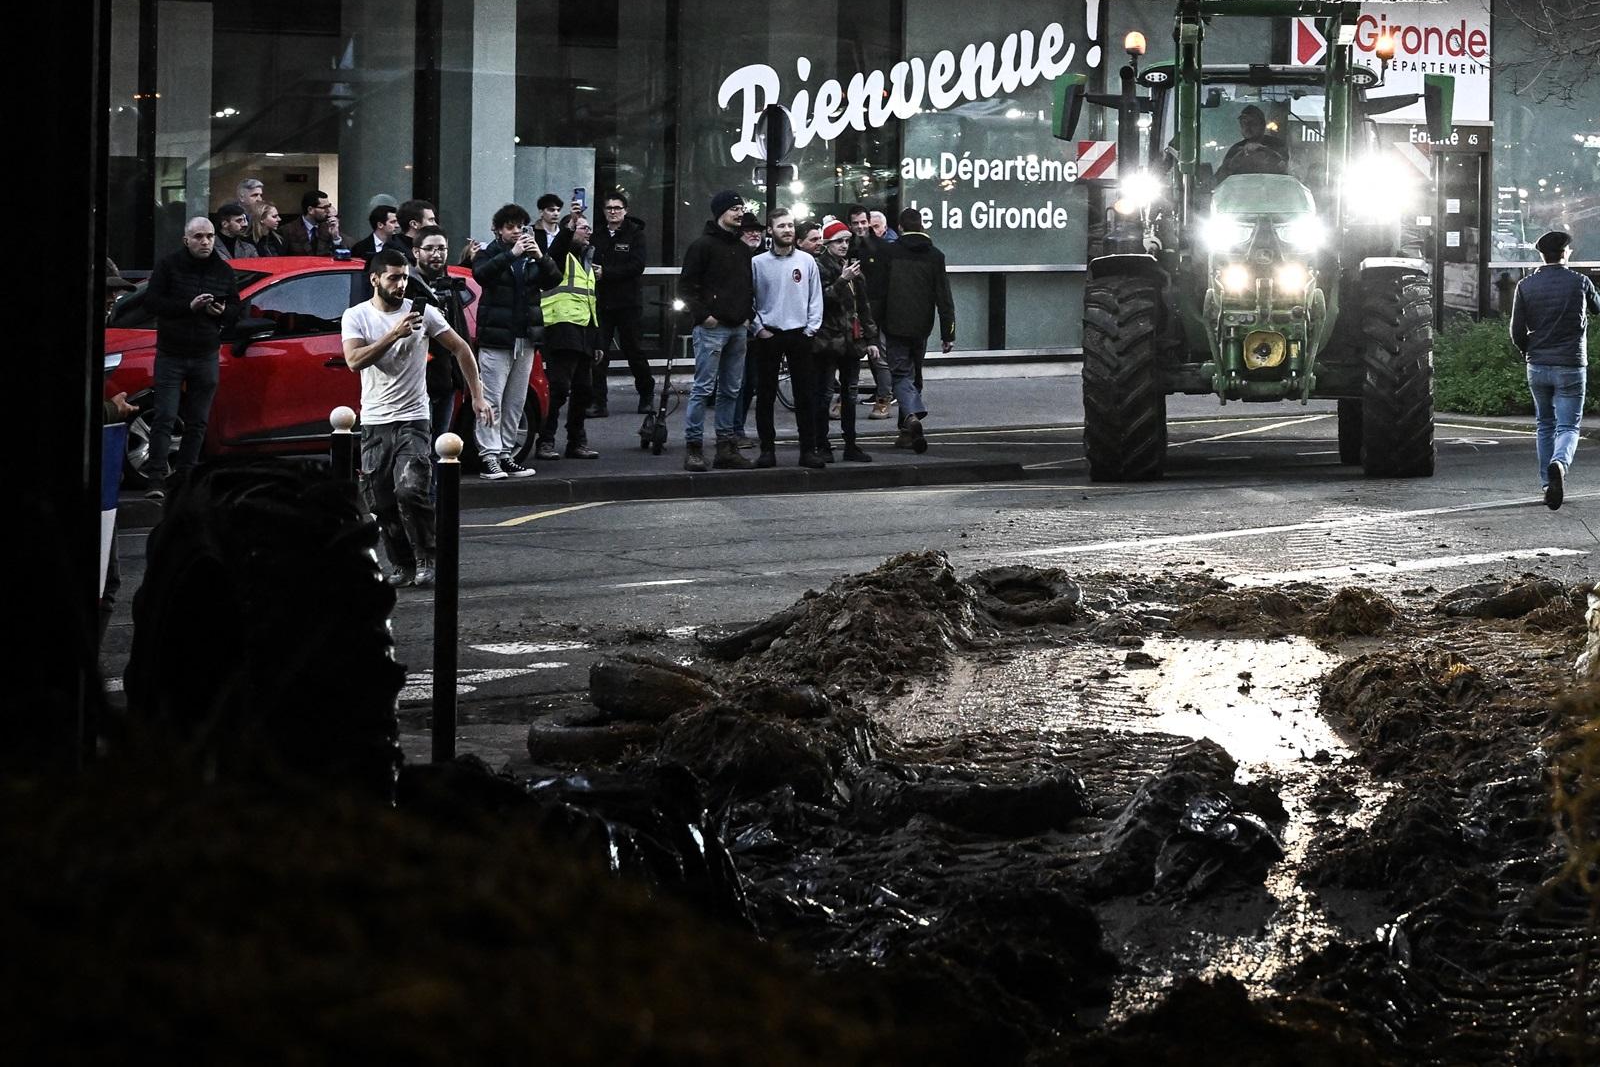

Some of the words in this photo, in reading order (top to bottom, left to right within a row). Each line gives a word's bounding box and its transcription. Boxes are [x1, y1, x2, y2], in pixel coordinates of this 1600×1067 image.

[1355, 13, 1488, 58] Gironde
[1389, 57, 1486, 75] ÉPARTEMENT
[718, 22, 1076, 163] Bienvenue
[1468, 134, 1479, 145] 45
[901, 157, 931, 180] au
[940, 151, 1078, 188] Départeme
[942, 200, 963, 229] la
[970, 200, 1068, 230] Gironde
